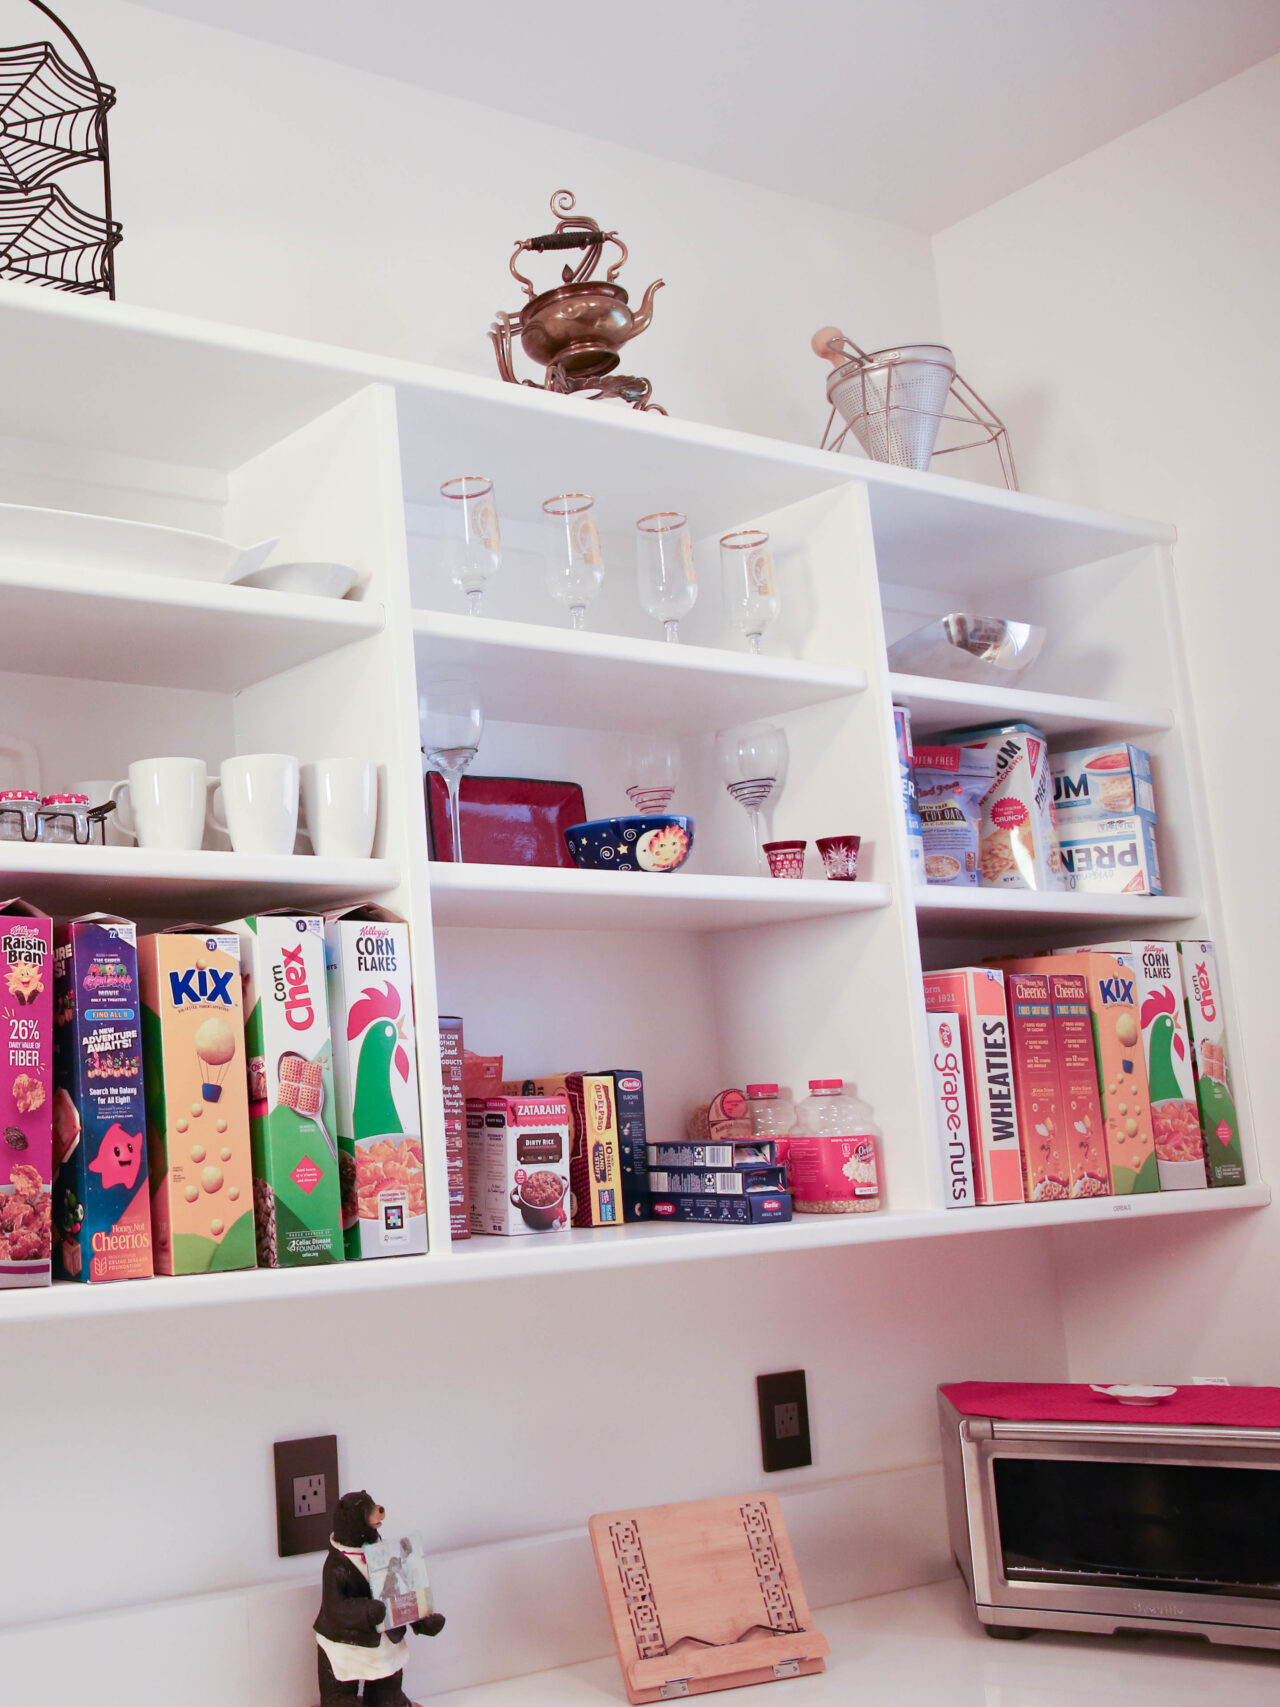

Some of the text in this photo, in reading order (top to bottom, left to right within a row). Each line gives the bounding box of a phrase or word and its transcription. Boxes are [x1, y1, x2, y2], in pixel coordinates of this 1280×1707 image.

[989, 755, 1023, 794] CRACKERS
[994, 815, 1024, 823] CRUNCH
[360, 926, 389, 939] Kellogg's
[2, 936, 47, 953] Raisin
[356, 937, 395, 956] CORN
[8, 950, 43, 965] Bran
[357, 956, 397, 972] FLAKES
[1142, 953, 1169, 967] CORN
[1144, 968, 1171, 979] FLAKES
[272, 964, 286, 1002] Corn
[281, 944, 314, 1031] Chex
[1192, 975, 1201, 1001] Corn
[1016, 984, 1047, 999] Cheerios
[1054, 984, 1085, 999] Cheerios
[1195, 961, 1216, 1022] Chex
[9, 1019, 40, 1040] 26%
[98, 1027, 115, 1036] NEW
[82, 1030, 138, 1045] ADVENTURE
[87, 1039, 132, 1054] AWAITS!
[9, 1050, 39, 1066] FIBER
[982, 1021, 1015, 1142] WHEATIES
[89, 1087, 137, 1096] Search the Galaxy
[594, 1084, 602, 1100] OLD
[598, 1100, 604, 1109] EL
[97, 1096, 107, 1105] for
[107, 1096, 115, 1104] All
[517, 1104, 567, 1116] ZATARAIN'S
[934, 1052, 968, 1200] grape-nuts
[606, 1141, 613, 1155] 10
[112, 1223, 145, 1233] Honey Nut
[91, 1231, 149, 1252] Cheerios
[295, 1244, 332, 1252] FOUNDATION
